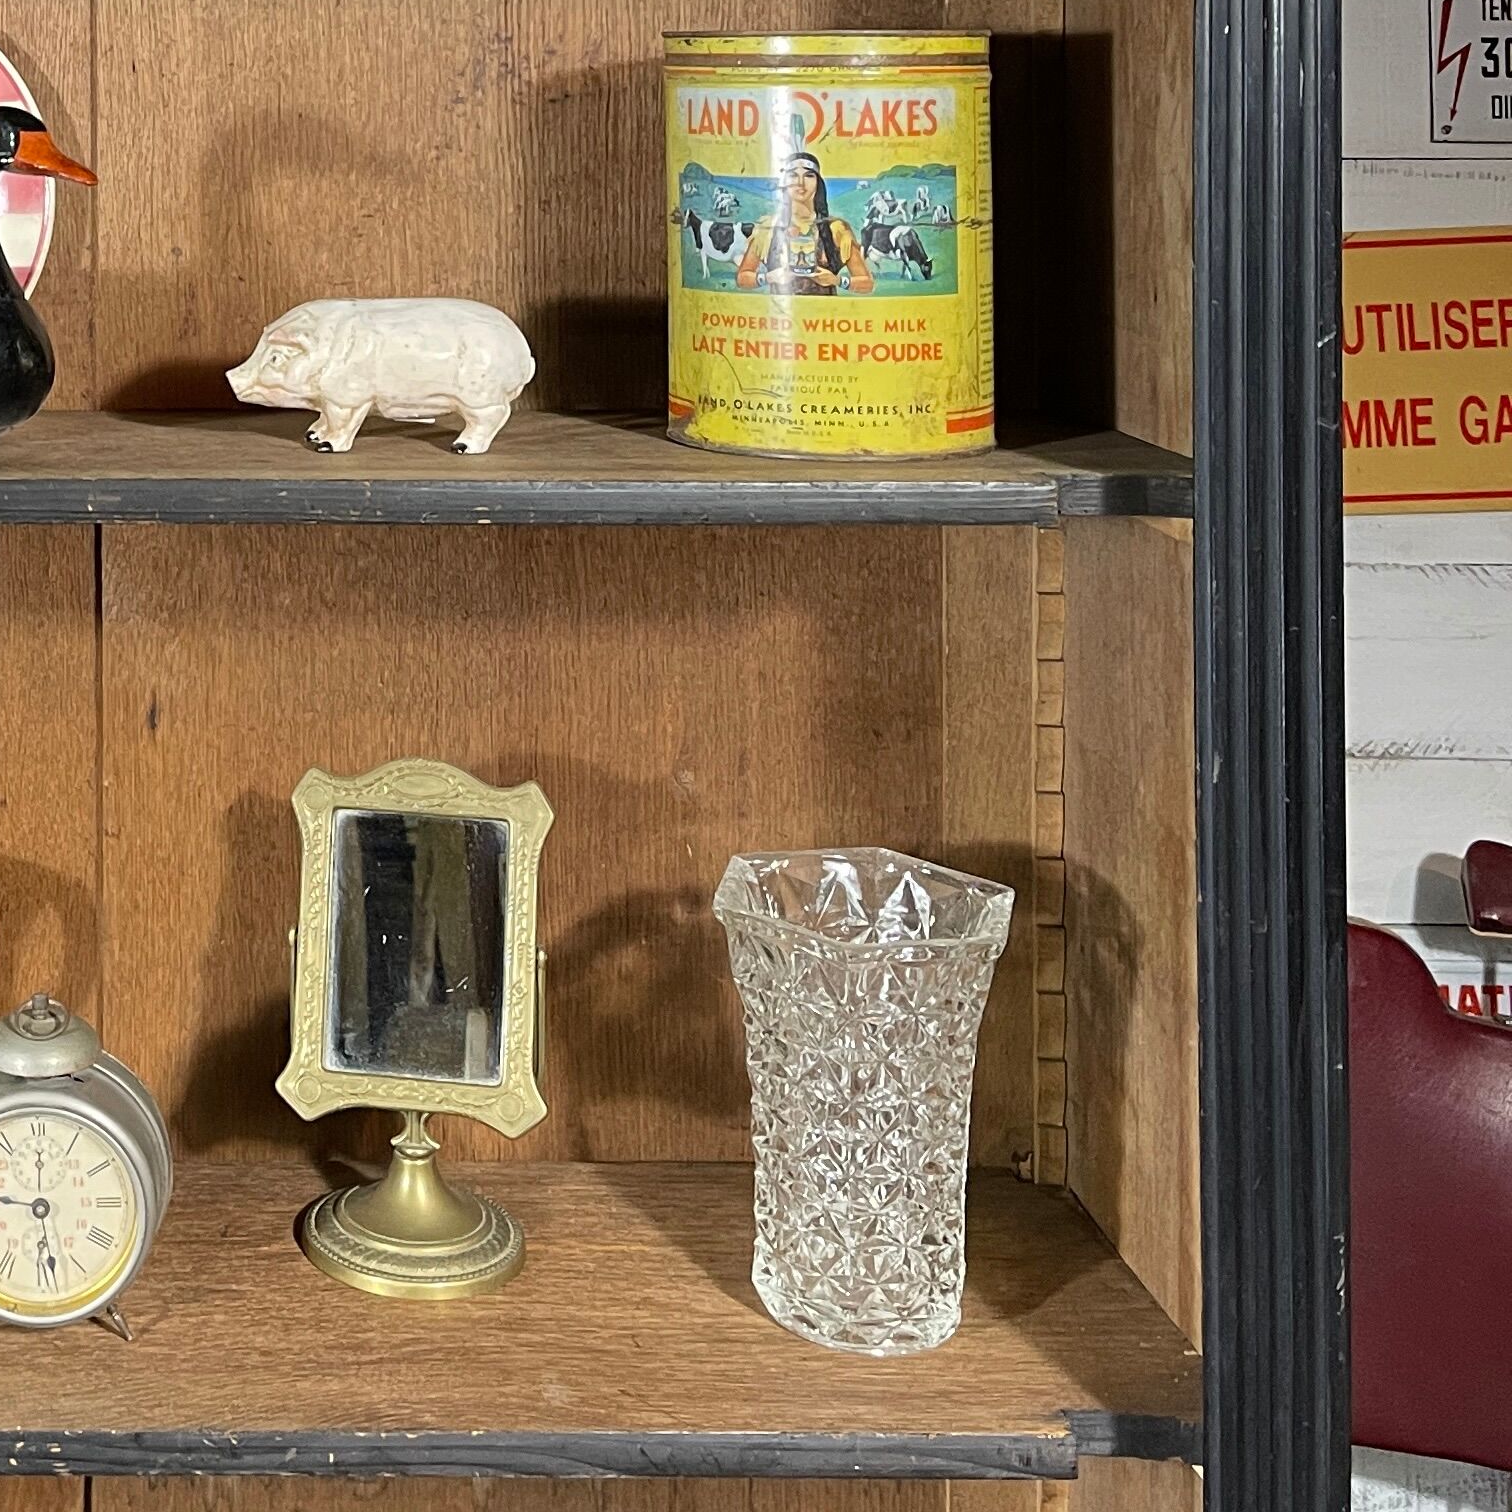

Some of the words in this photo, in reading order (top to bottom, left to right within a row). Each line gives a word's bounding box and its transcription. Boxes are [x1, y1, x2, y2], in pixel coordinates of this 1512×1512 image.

[687, 97, 760, 137] LAND
[701, 312, 793, 331] POWDERED
[803, 318, 874, 333] WHOLE
[884, 318, 927, 332] MILK
[692, 334, 727, 355] LAIT
[734, 338, 808, 361] ENTIER
[818, 344, 848, 362] EN
[857, 342, 943, 362] POUDRE
